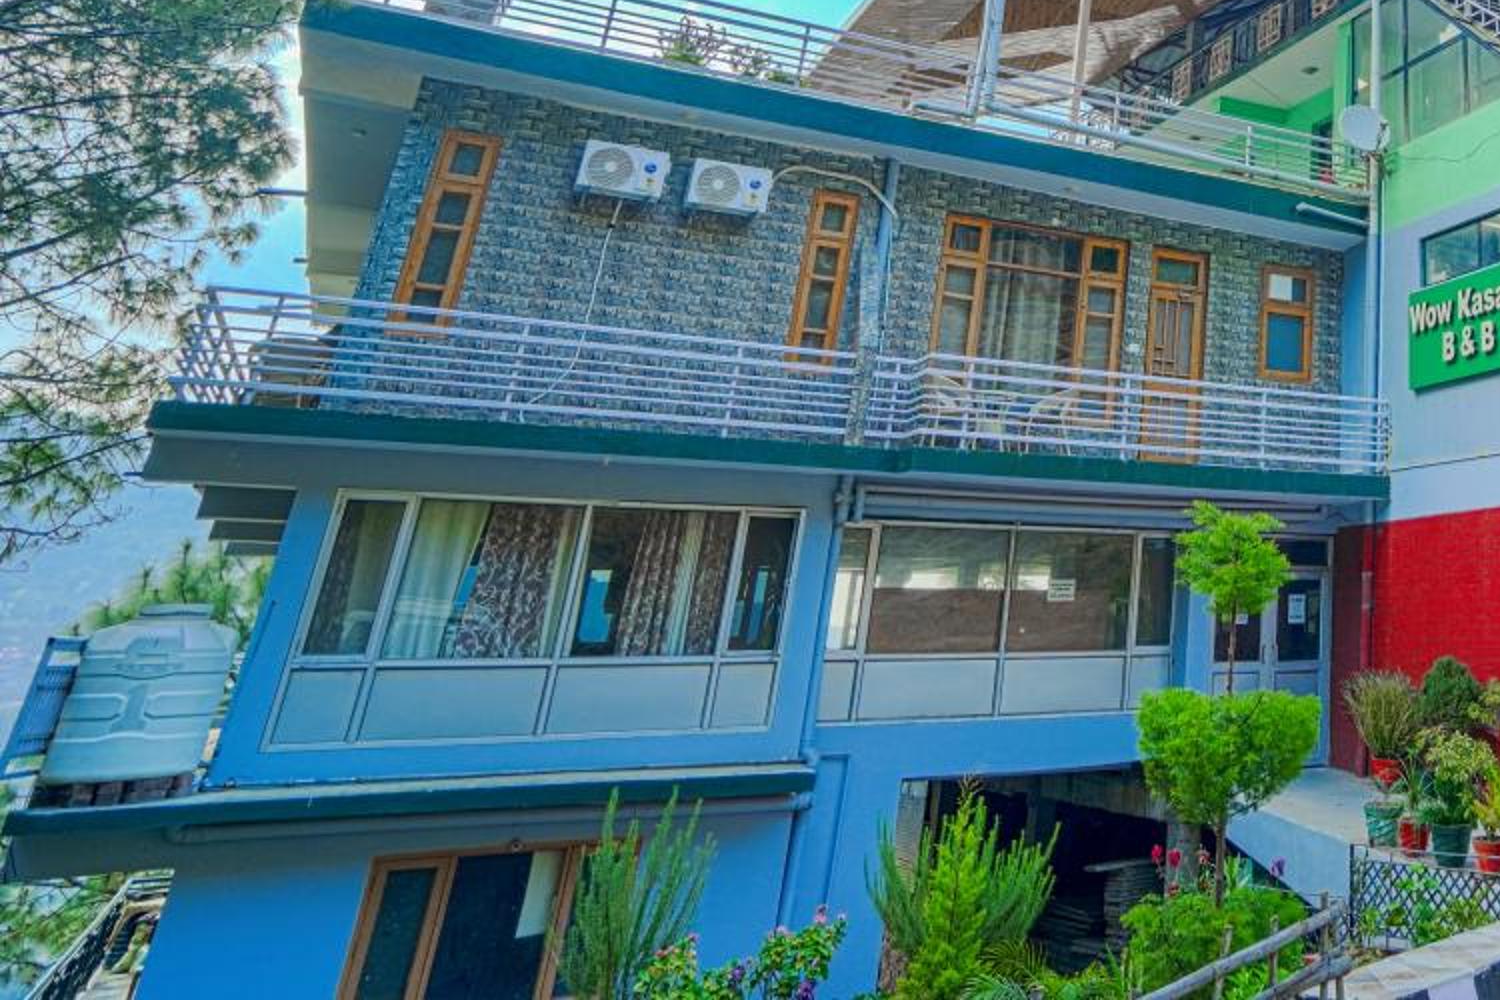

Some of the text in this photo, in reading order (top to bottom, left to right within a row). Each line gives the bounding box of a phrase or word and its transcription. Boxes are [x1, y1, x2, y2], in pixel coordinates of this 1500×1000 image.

[1409, 300, 1452, 334] Wow
[1442, 320, 1495, 362] B & B
